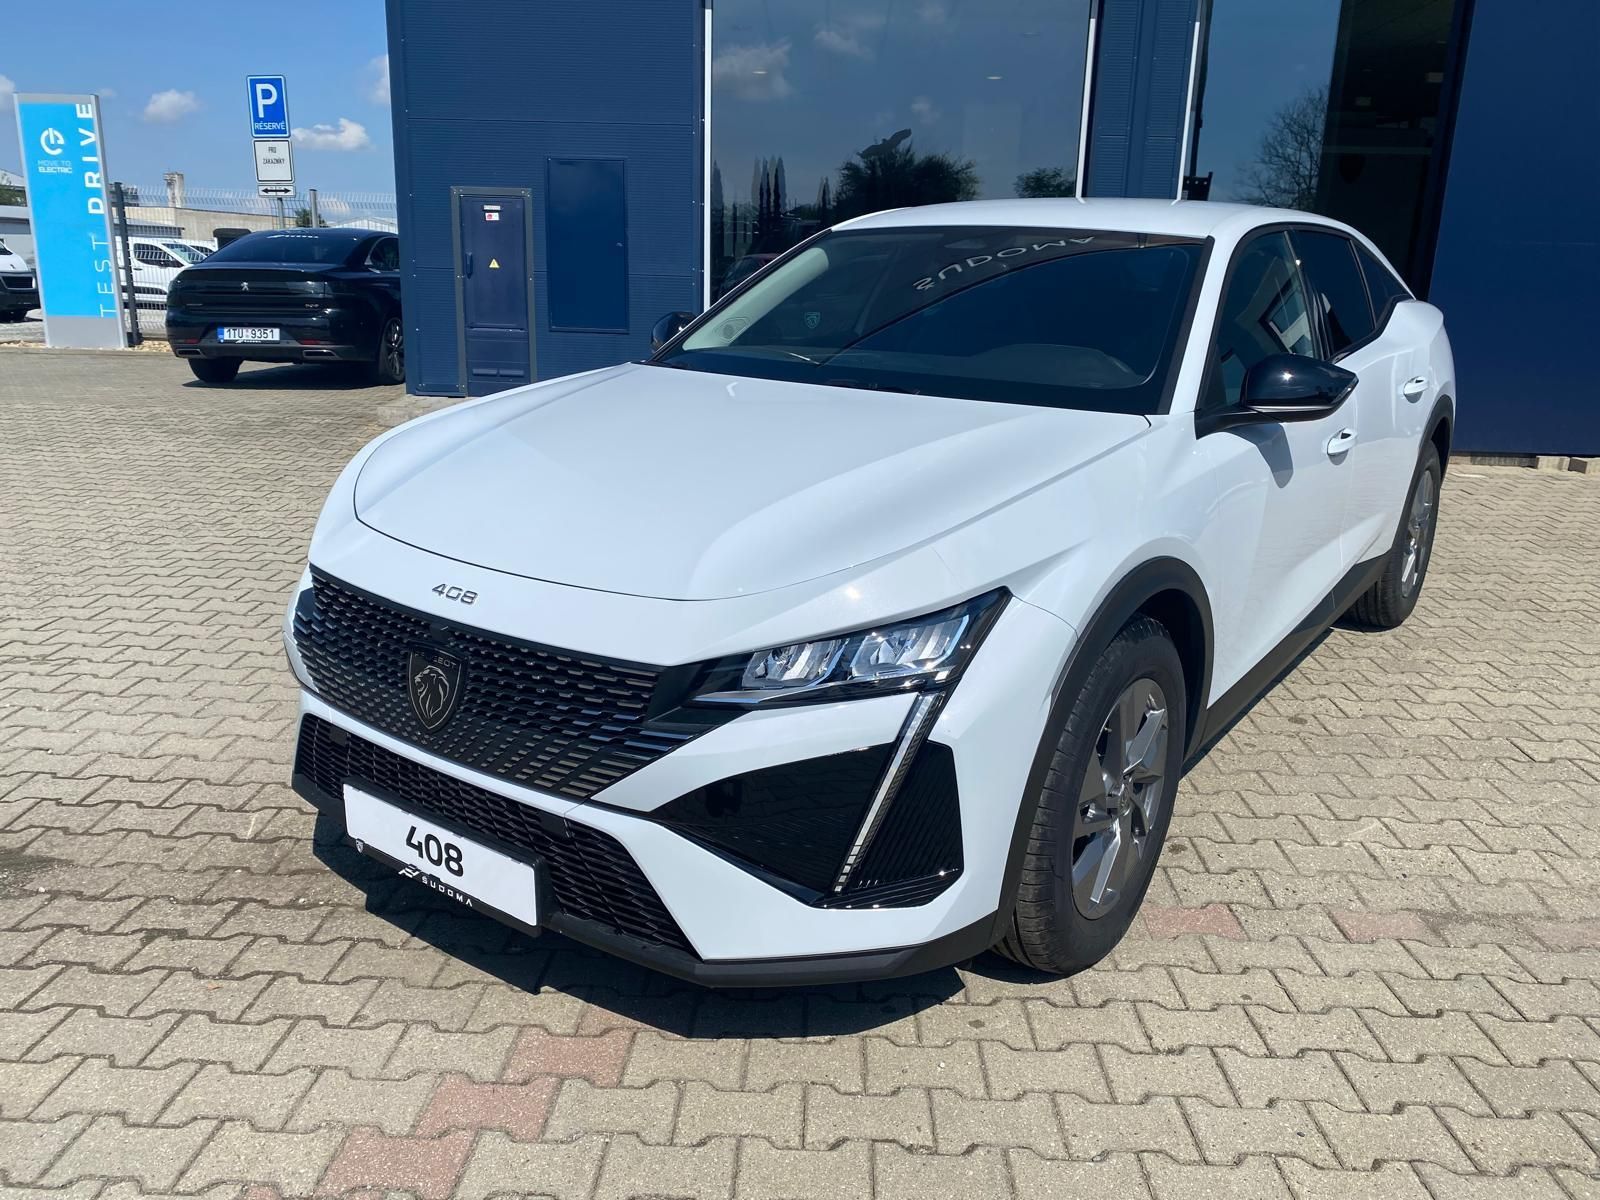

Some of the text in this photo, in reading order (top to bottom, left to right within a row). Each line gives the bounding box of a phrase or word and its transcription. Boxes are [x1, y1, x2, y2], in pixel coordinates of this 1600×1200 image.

[255, 83, 278, 118] P
[37, 159, 59, 167] MOVE
[38, 166, 72, 174] ELECTRIC
[75, 103, 117, 318] TEST DRIVE
[226, 328, 274, 339] 1TU 9351
[431, 583, 478, 605] 408
[405, 825, 464, 877] 408
